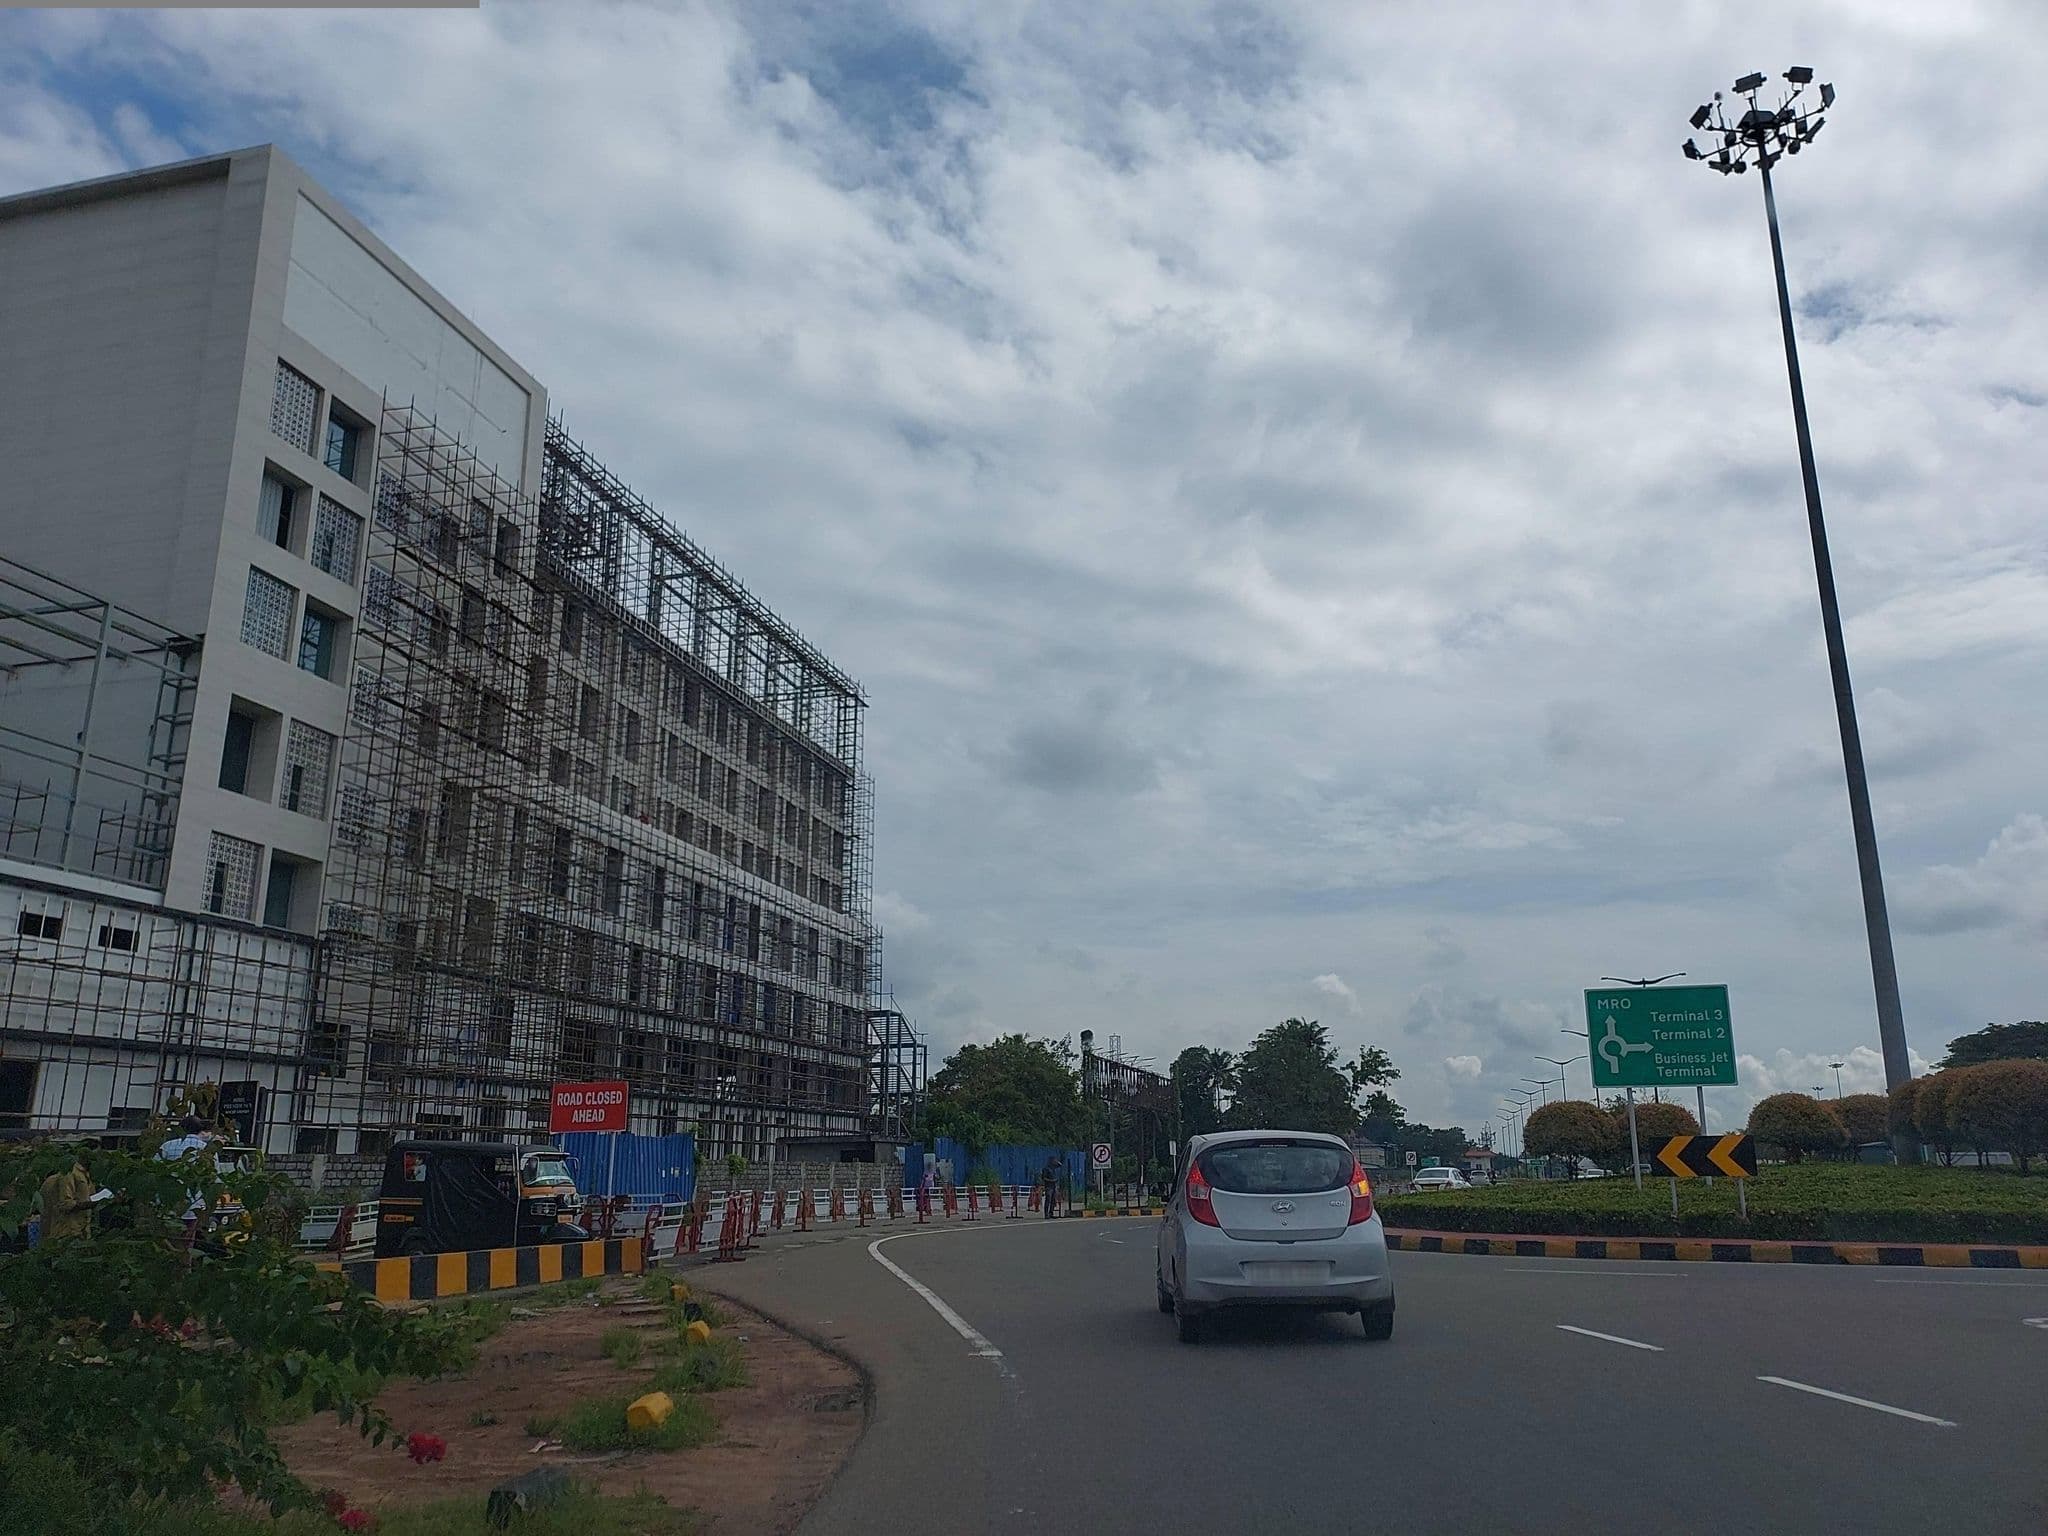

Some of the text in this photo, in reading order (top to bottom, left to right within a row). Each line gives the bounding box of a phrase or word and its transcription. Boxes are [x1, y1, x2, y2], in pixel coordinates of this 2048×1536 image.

[1597, 999, 1632, 1010] MRO
[1650, 1009, 1723, 1022] Terminal 3
[1653, 1027, 1726, 1040] Terminal 2
[1655, 1052, 1729, 1064] Business Jet
[1657, 1066, 1717, 1077] Terminal
[557, 1090, 623, 1106] ROAD CLOSED
[571, 1109, 605, 1123] AHEAD
